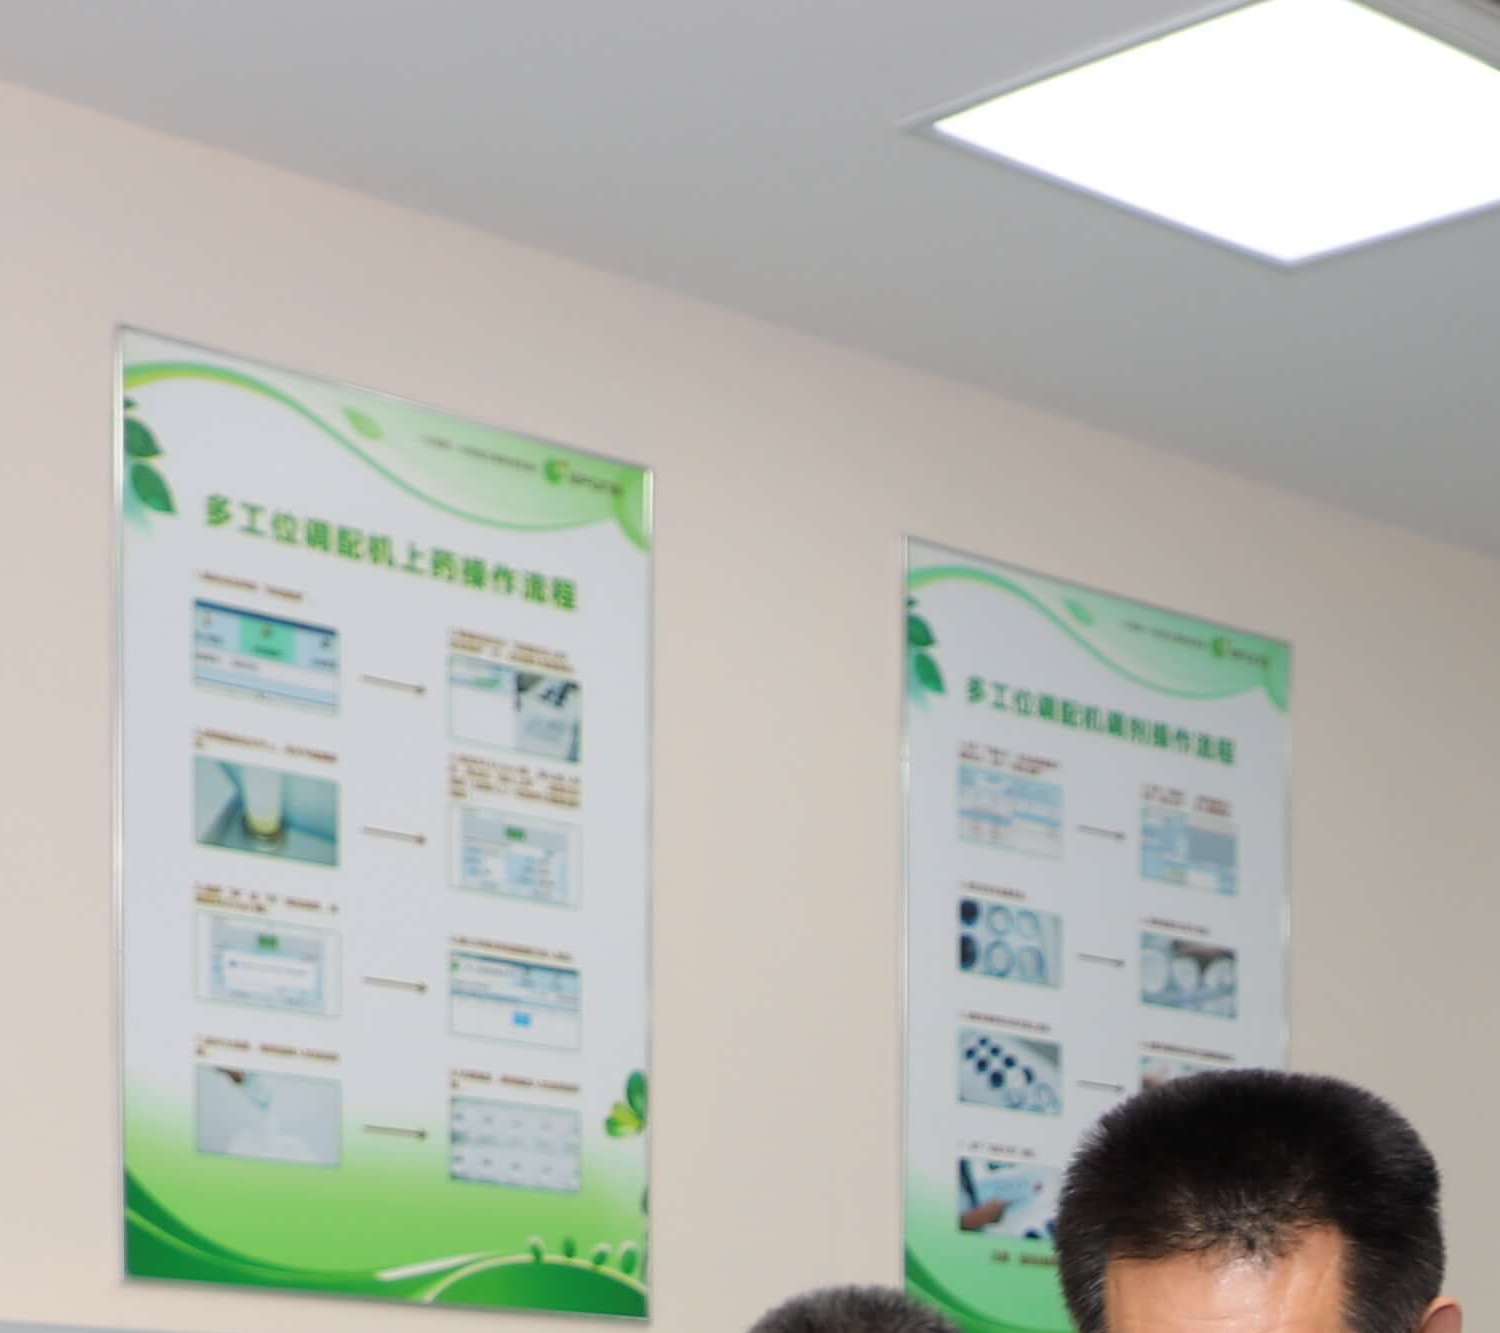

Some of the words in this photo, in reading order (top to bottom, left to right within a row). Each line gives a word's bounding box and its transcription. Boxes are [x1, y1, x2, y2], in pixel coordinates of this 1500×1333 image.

[203, 492, 579, 613] 多工位调配机上药操作流程
